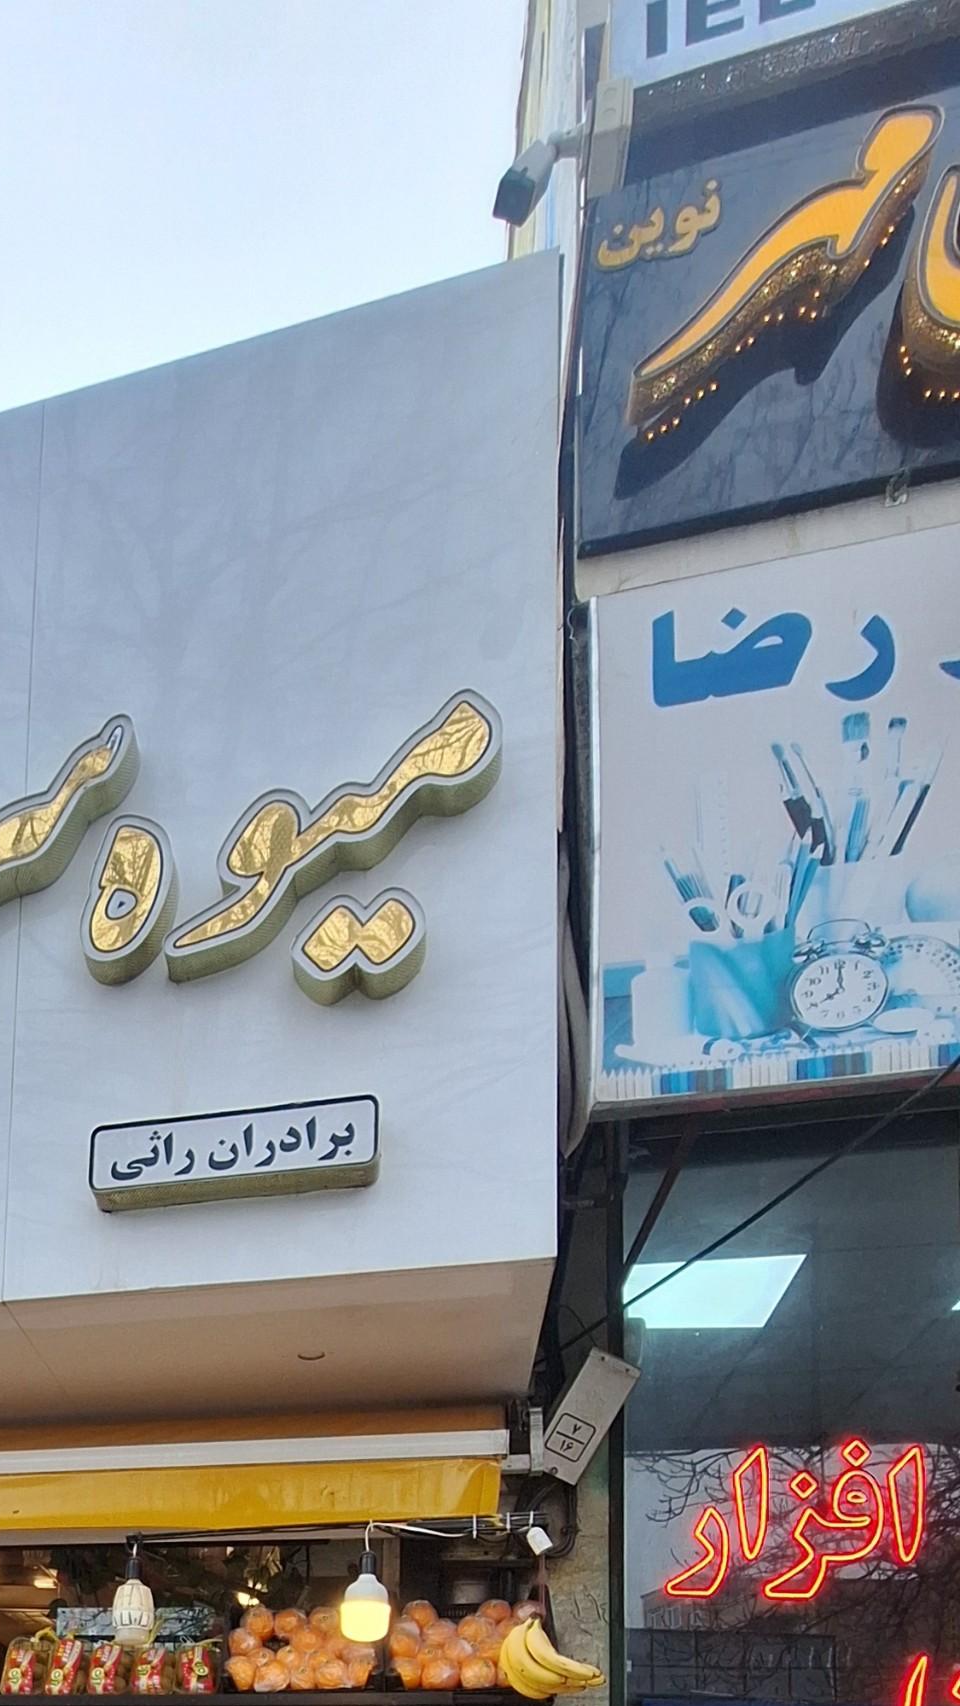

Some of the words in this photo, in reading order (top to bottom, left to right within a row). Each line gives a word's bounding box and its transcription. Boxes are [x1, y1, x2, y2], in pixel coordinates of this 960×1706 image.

[596, 179, 722, 270] نوین
[652, 607, 897, 707] رضا
[82, 689, 502, 1000] میوه
[111, 1130, 195, 1181] راثی
[208, 1115, 355, 1171] برادران
[666, 1440, 925, 1600] افزار
